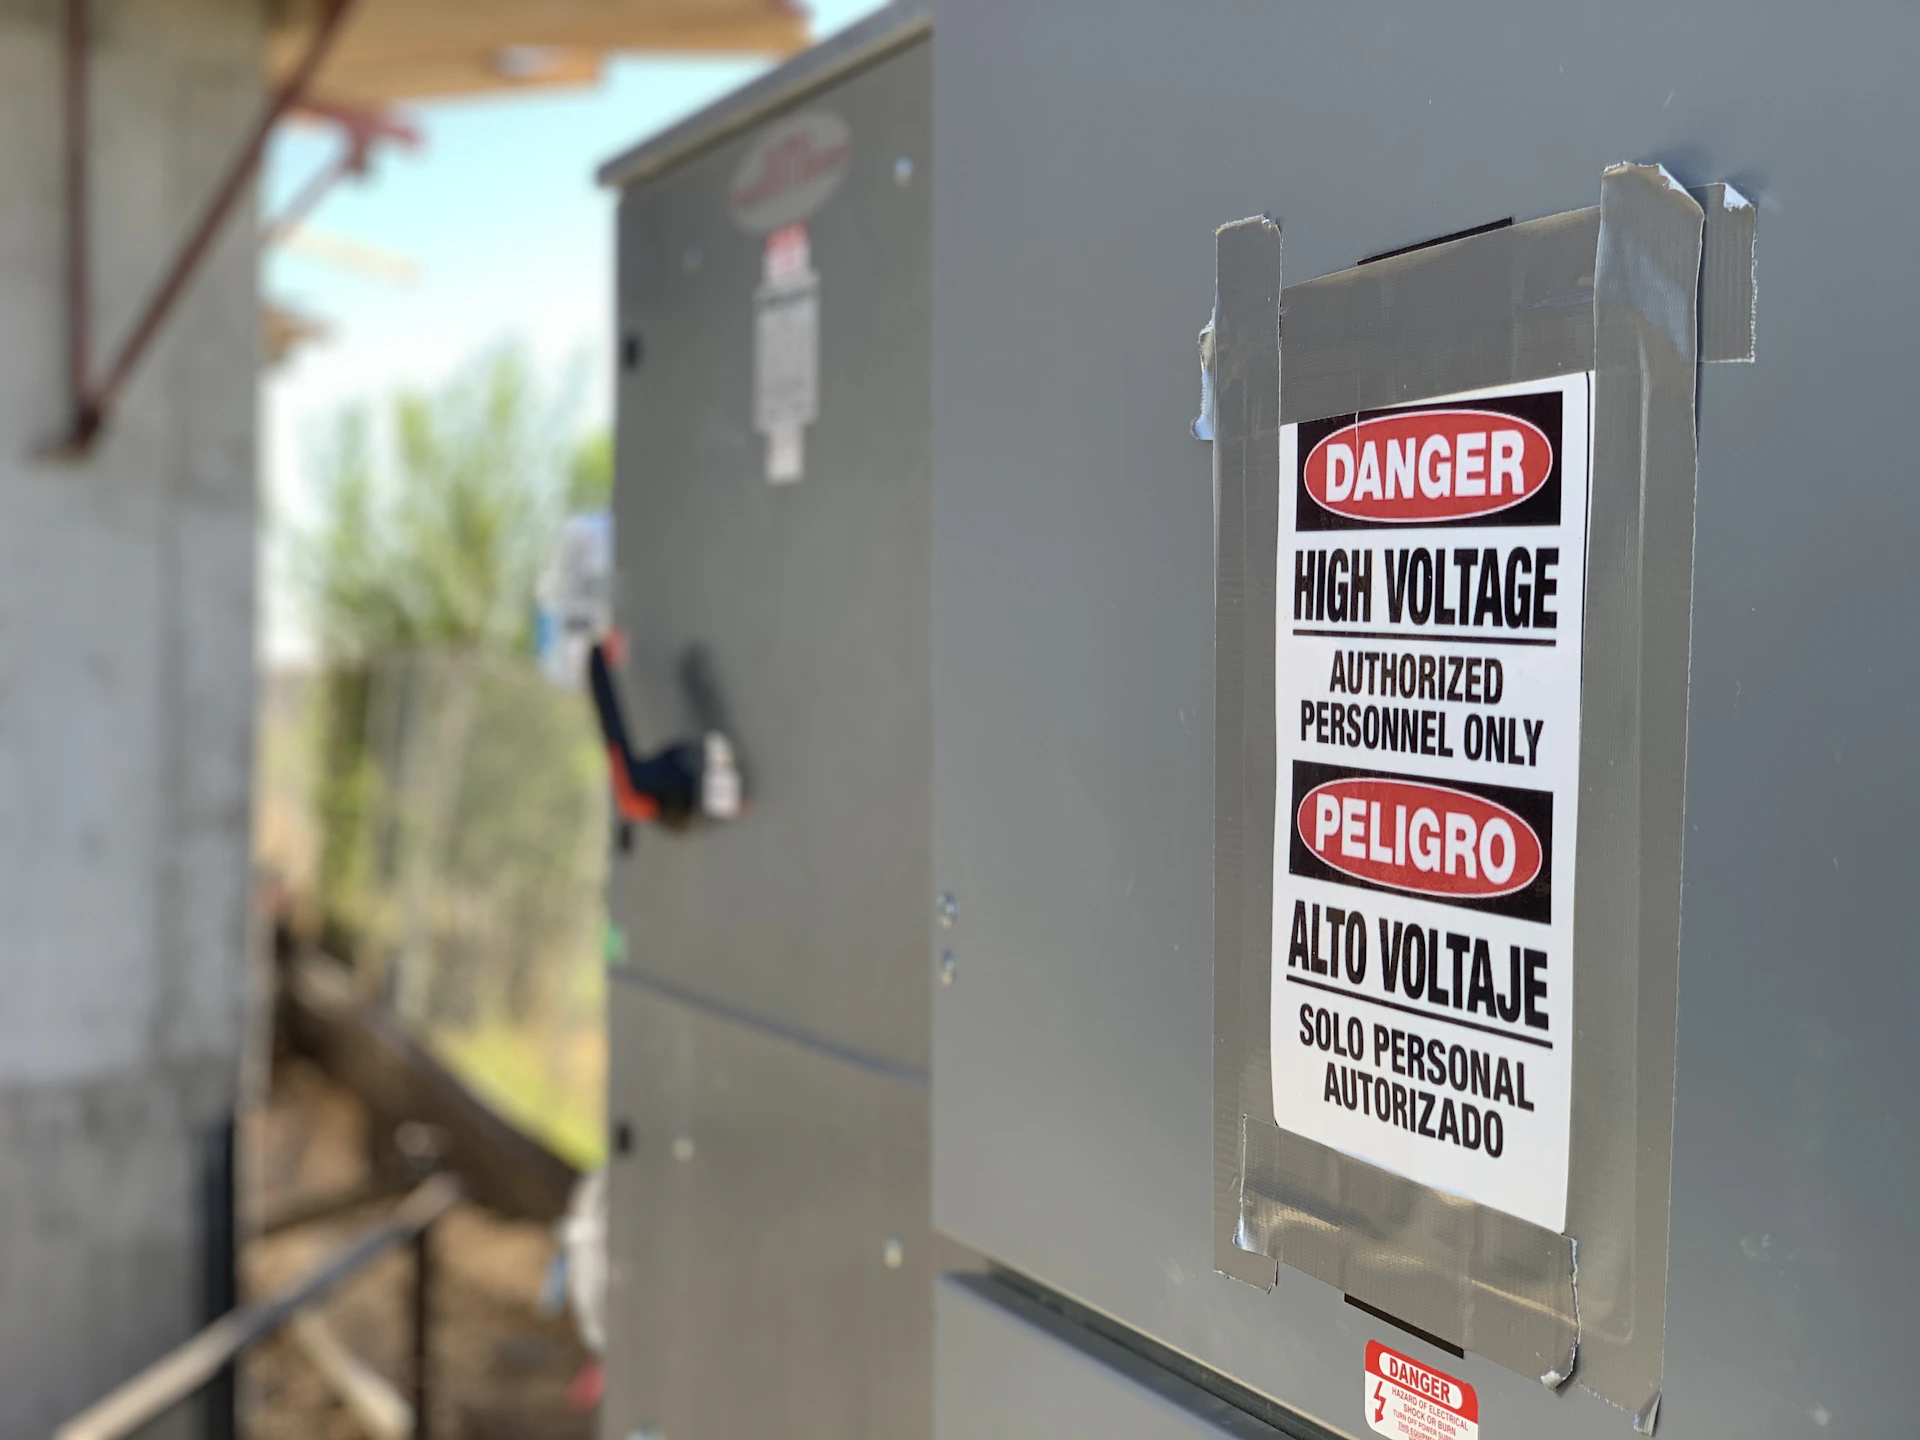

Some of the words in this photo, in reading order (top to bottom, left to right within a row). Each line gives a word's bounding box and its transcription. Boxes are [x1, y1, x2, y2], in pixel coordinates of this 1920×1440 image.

[1325, 429, 1525, 503] DANGER
[1293, 548, 1373, 623] HIGH
[1385, 547, 1560, 629] VOLTAGE
[1329, 650, 1504, 705] AUTHORIZED
[1301, 700, 1454, 758] PERSONNEL
[1464, 714, 1544, 767] ONLY
[1314, 793, 1516, 885] PELIGRO
[1287, 900, 1367, 985] ALTO
[1379, 918, 1549, 1031] VOLTAJE
[1299, 1003, 1364, 1061] SOLO
[1374, 1024, 1535, 1112] PERSONAL
[1323, 1061, 1504, 1159] AUTORIZADO
[1389, 1357, 1451, 1404] DANGER
[1391, 1386, 1417, 1406] HAZARD
[1418, 1400, 1428, 1410] OF
[1428, 1406, 1469, 1432] ELECTRICAL
[1392, 1408, 1407, 1422] TURN
[1407, 1416, 1418, 1426] OFF
[1418, 1421, 1438, 1437] POWER
[1403, 1403, 1426, 1421] SHOCK
[1427, 1415, 1437, 1427] OR
[1437, 1420, 1457, 1436] BURN
